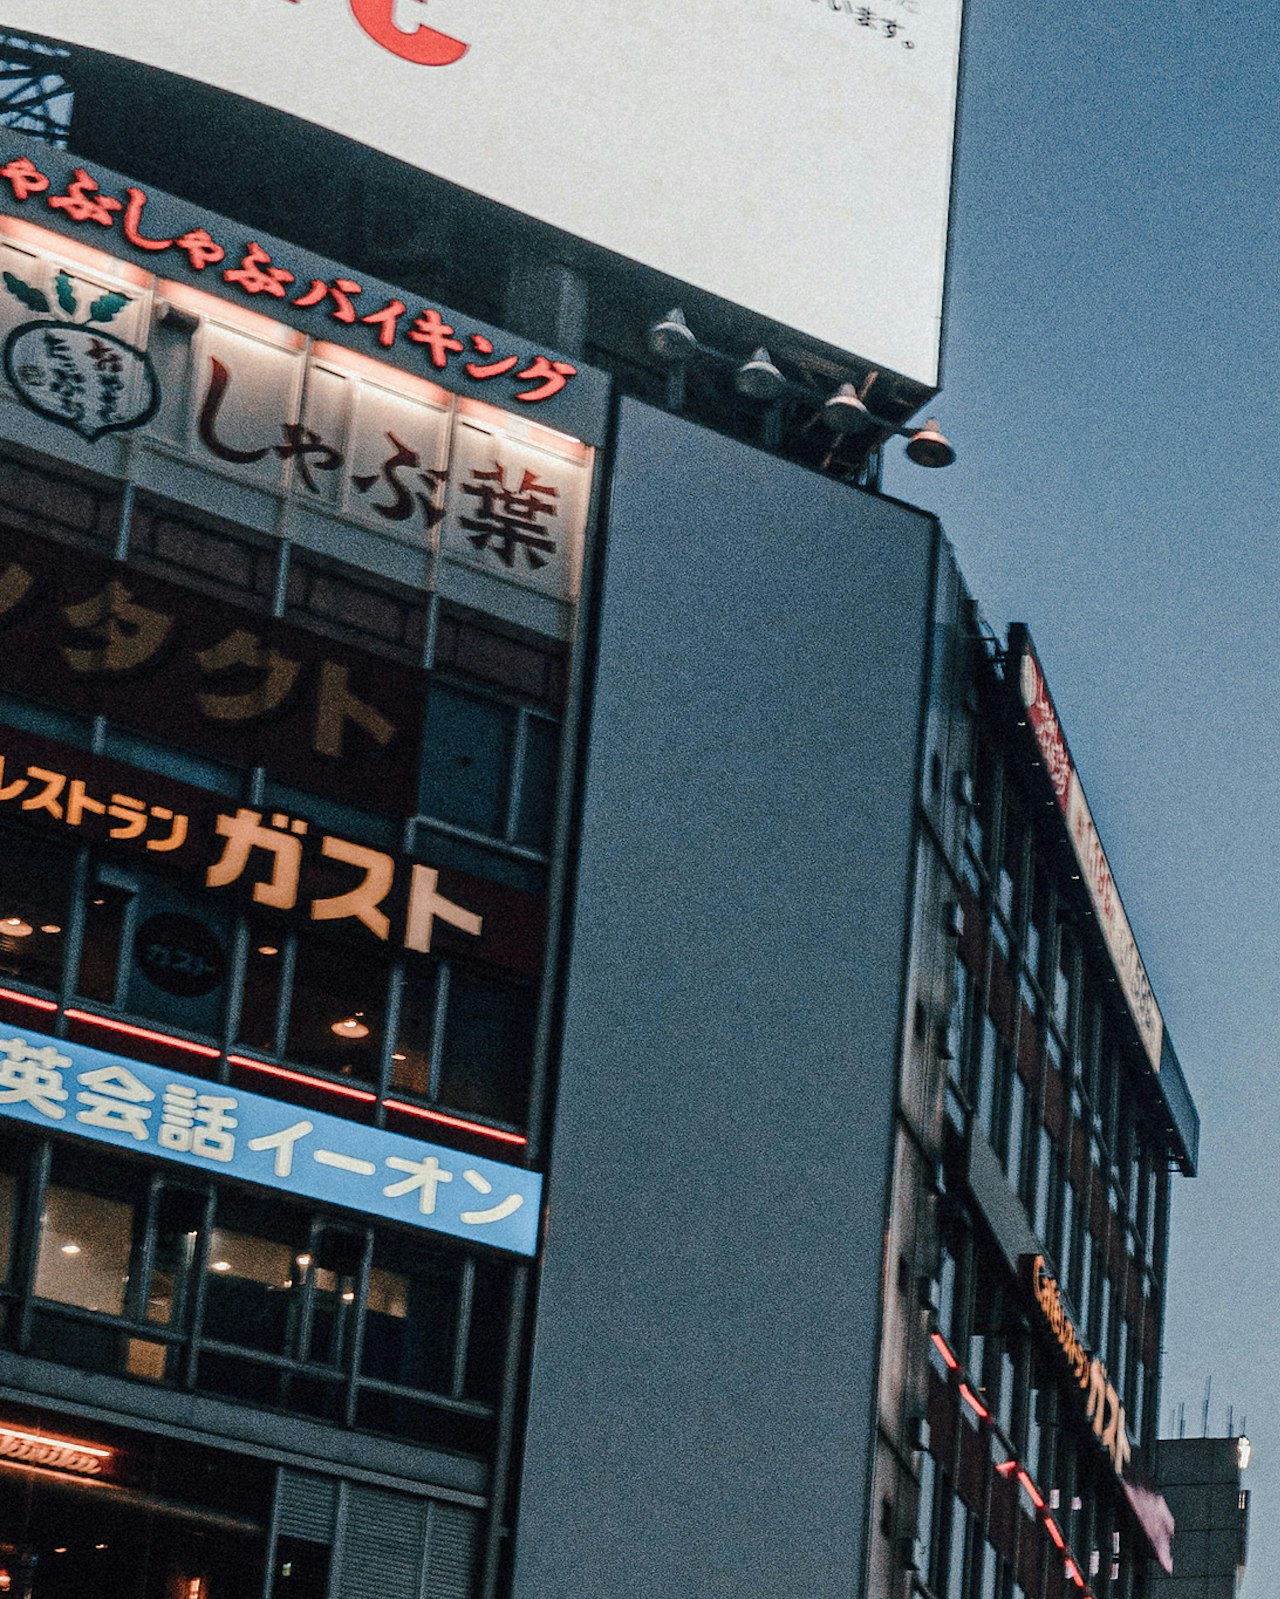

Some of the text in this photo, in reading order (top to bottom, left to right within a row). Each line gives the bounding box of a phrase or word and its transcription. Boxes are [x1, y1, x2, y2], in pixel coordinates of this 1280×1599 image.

[199, 355, 563, 571] しゃぶ葉
[206, 807, 484, 953] ガスト
[0, 1037, 525, 1226] 英会話イーオン
